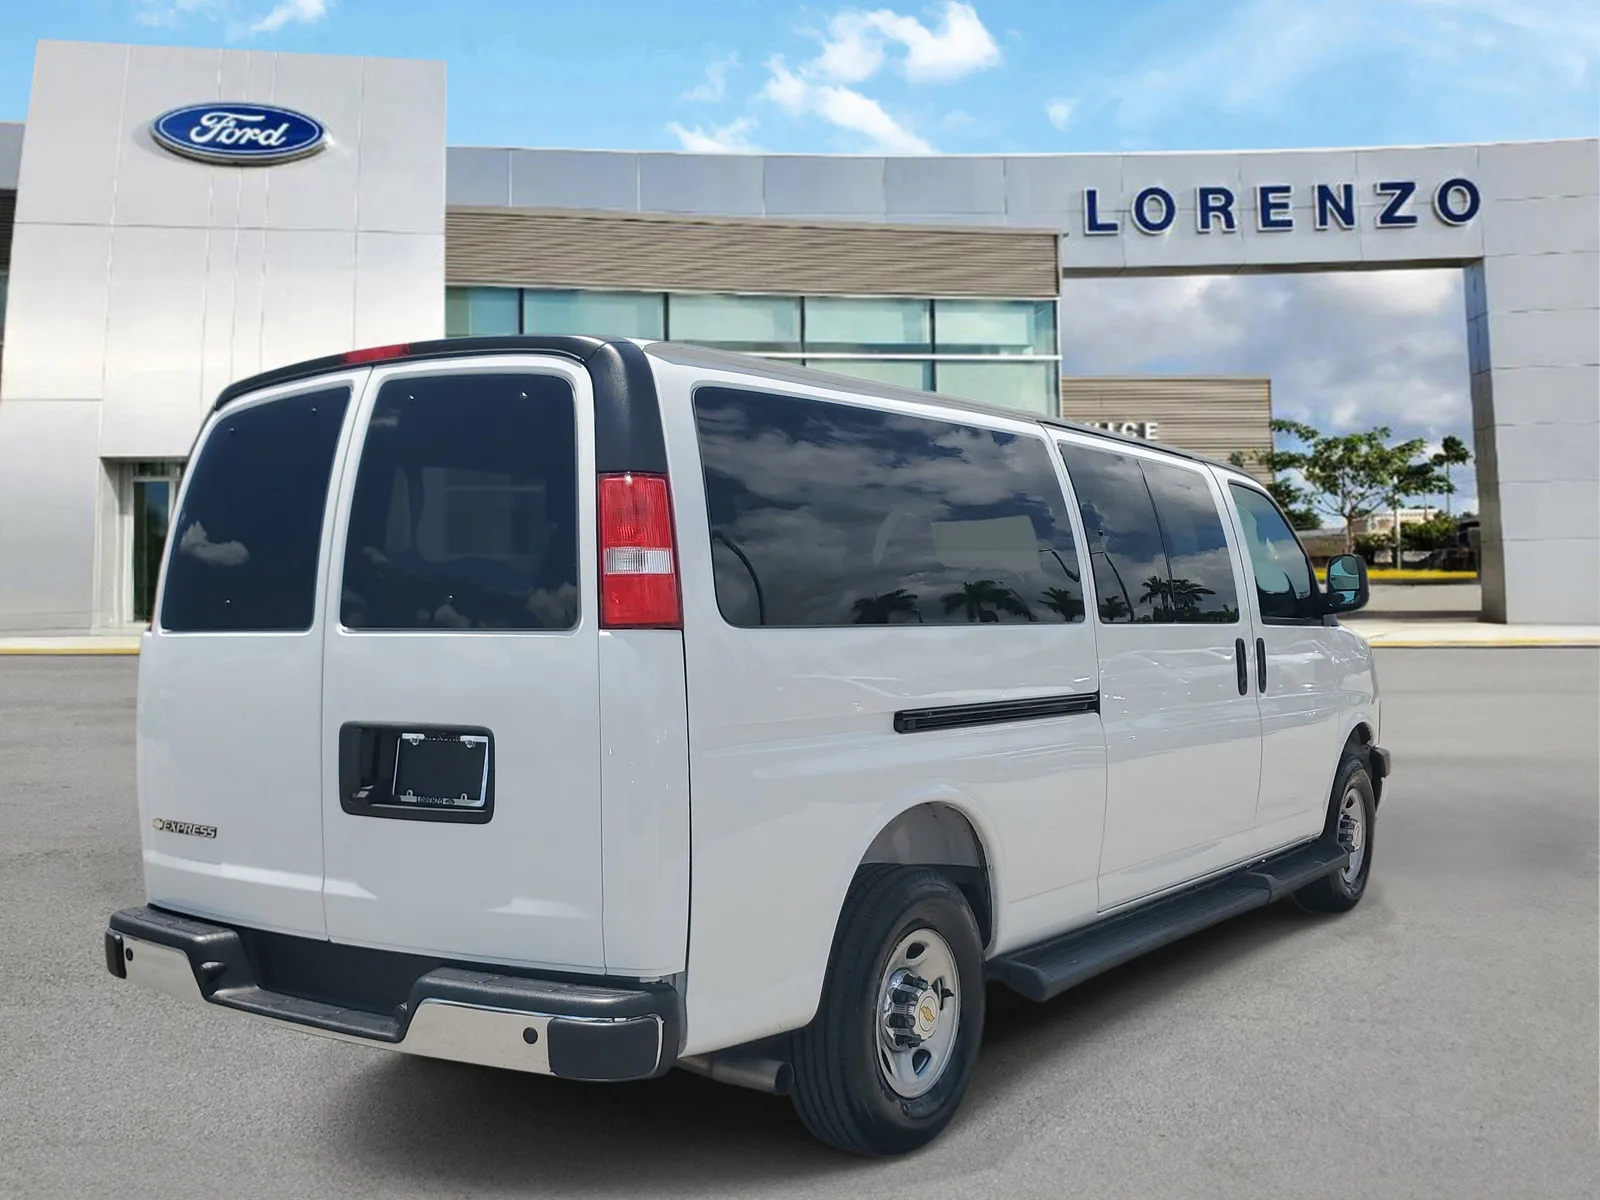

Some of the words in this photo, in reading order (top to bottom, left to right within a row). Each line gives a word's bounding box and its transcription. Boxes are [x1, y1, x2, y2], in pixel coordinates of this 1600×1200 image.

[189, 111, 290, 146] Ford
[1083, 178, 1481, 234] LORENZO
[163, 820, 217, 838] EXPRESS
